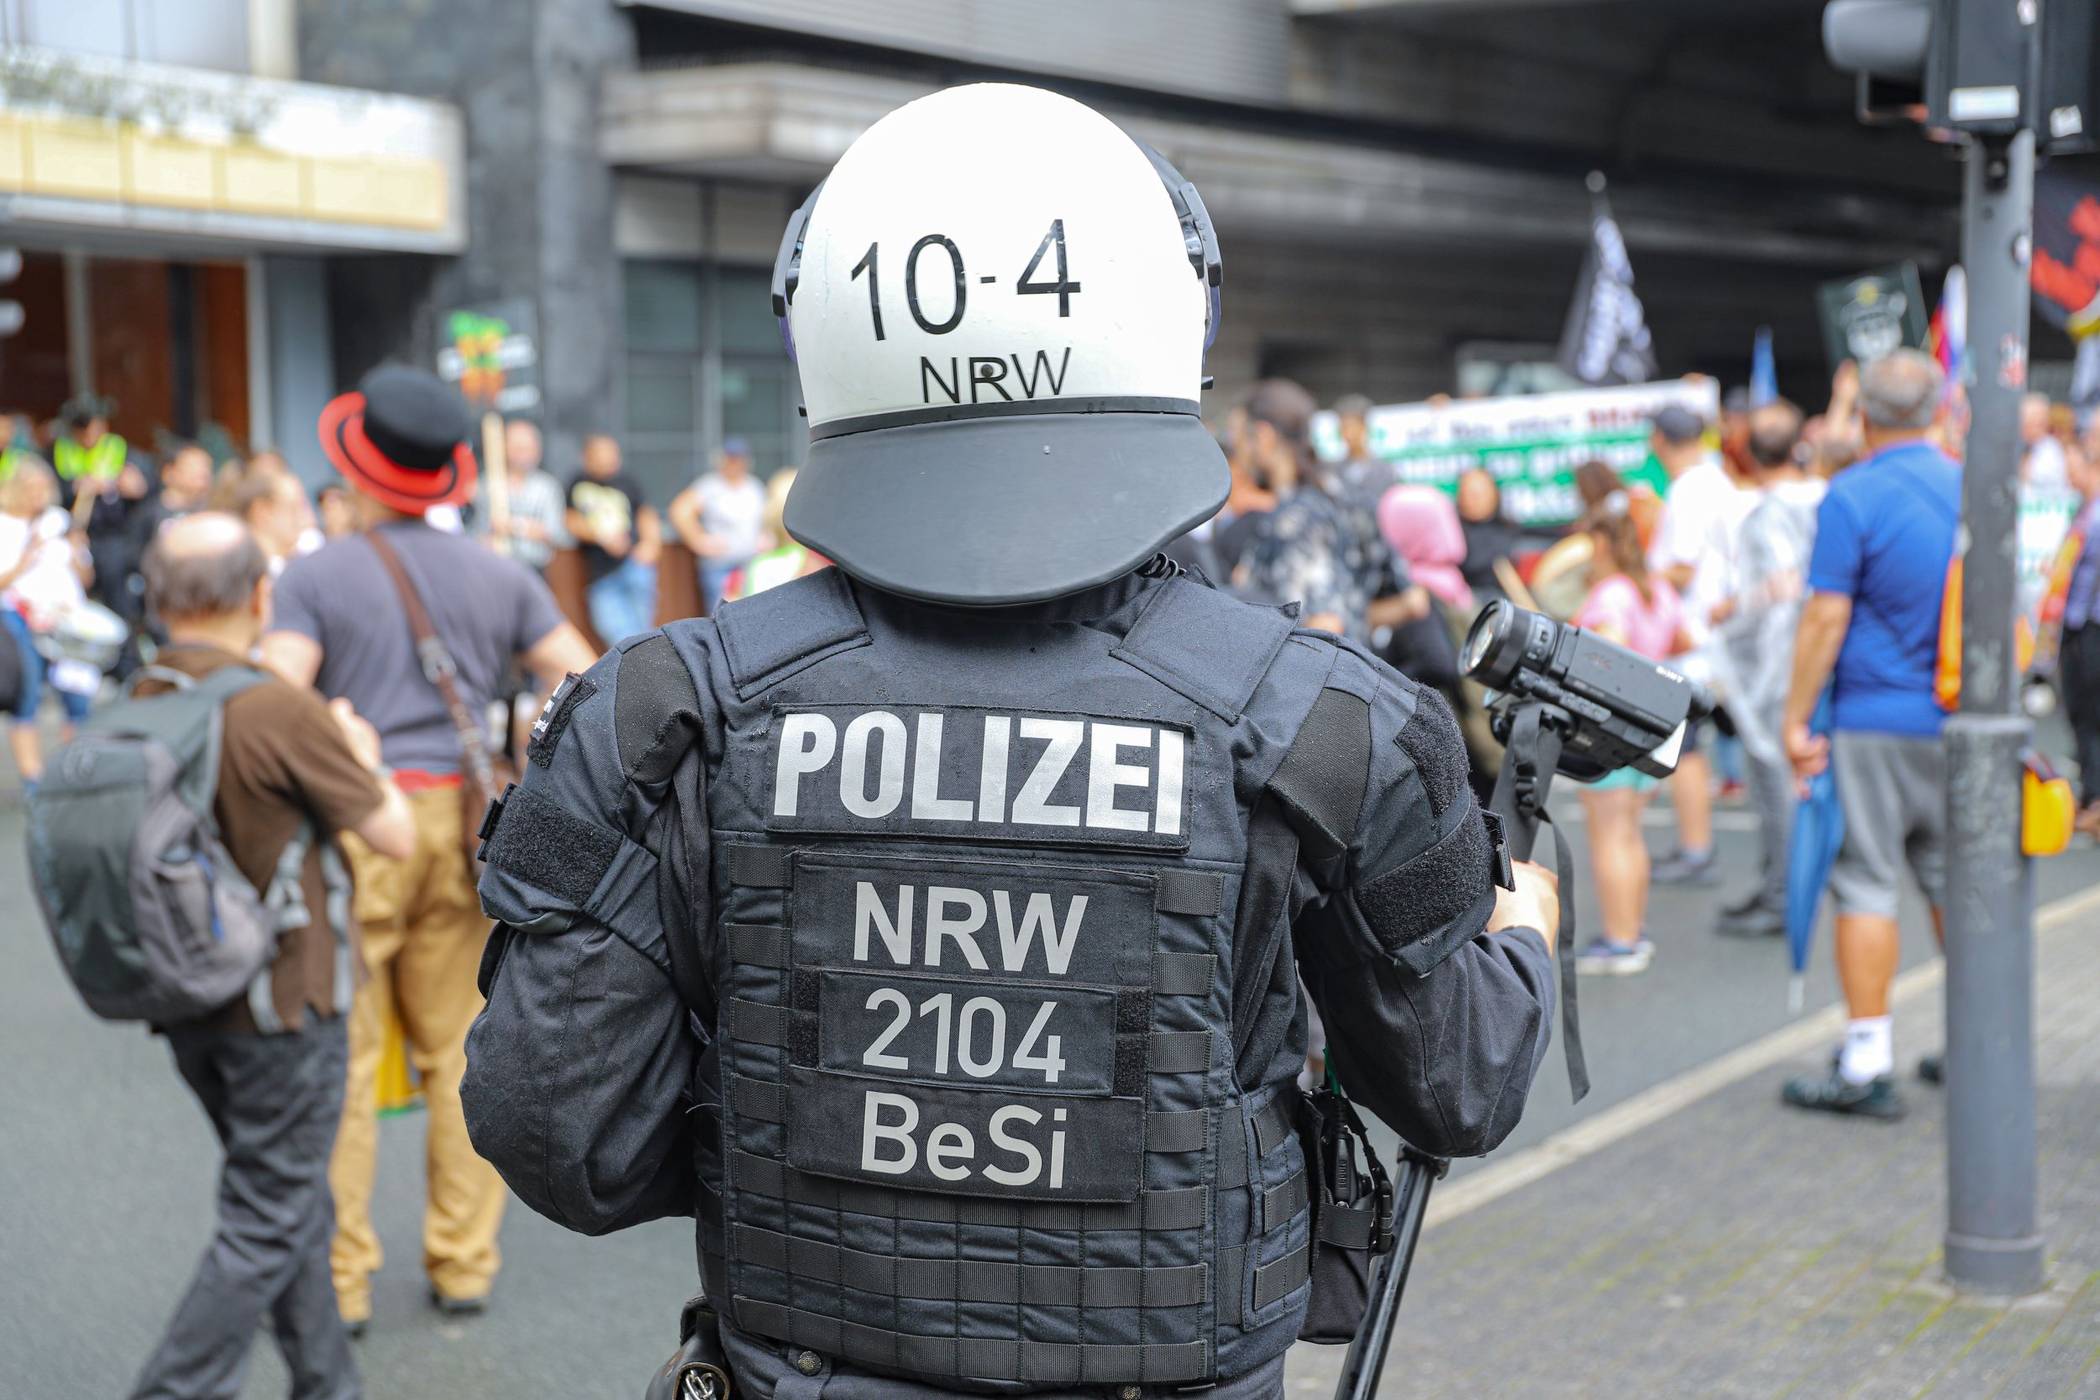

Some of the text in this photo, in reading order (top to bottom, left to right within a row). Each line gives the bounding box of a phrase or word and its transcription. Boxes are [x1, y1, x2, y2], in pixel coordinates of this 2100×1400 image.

[851, 219, 1081, 341] 10-4
[920, 347, 1071, 404] NRW
[773, 711, 1185, 836] POLIZEI
[853, 881, 1089, 975] NRW
[862, 988, 1066, 1083] 2104
[861, 1090, 1067, 1189] BeSi
